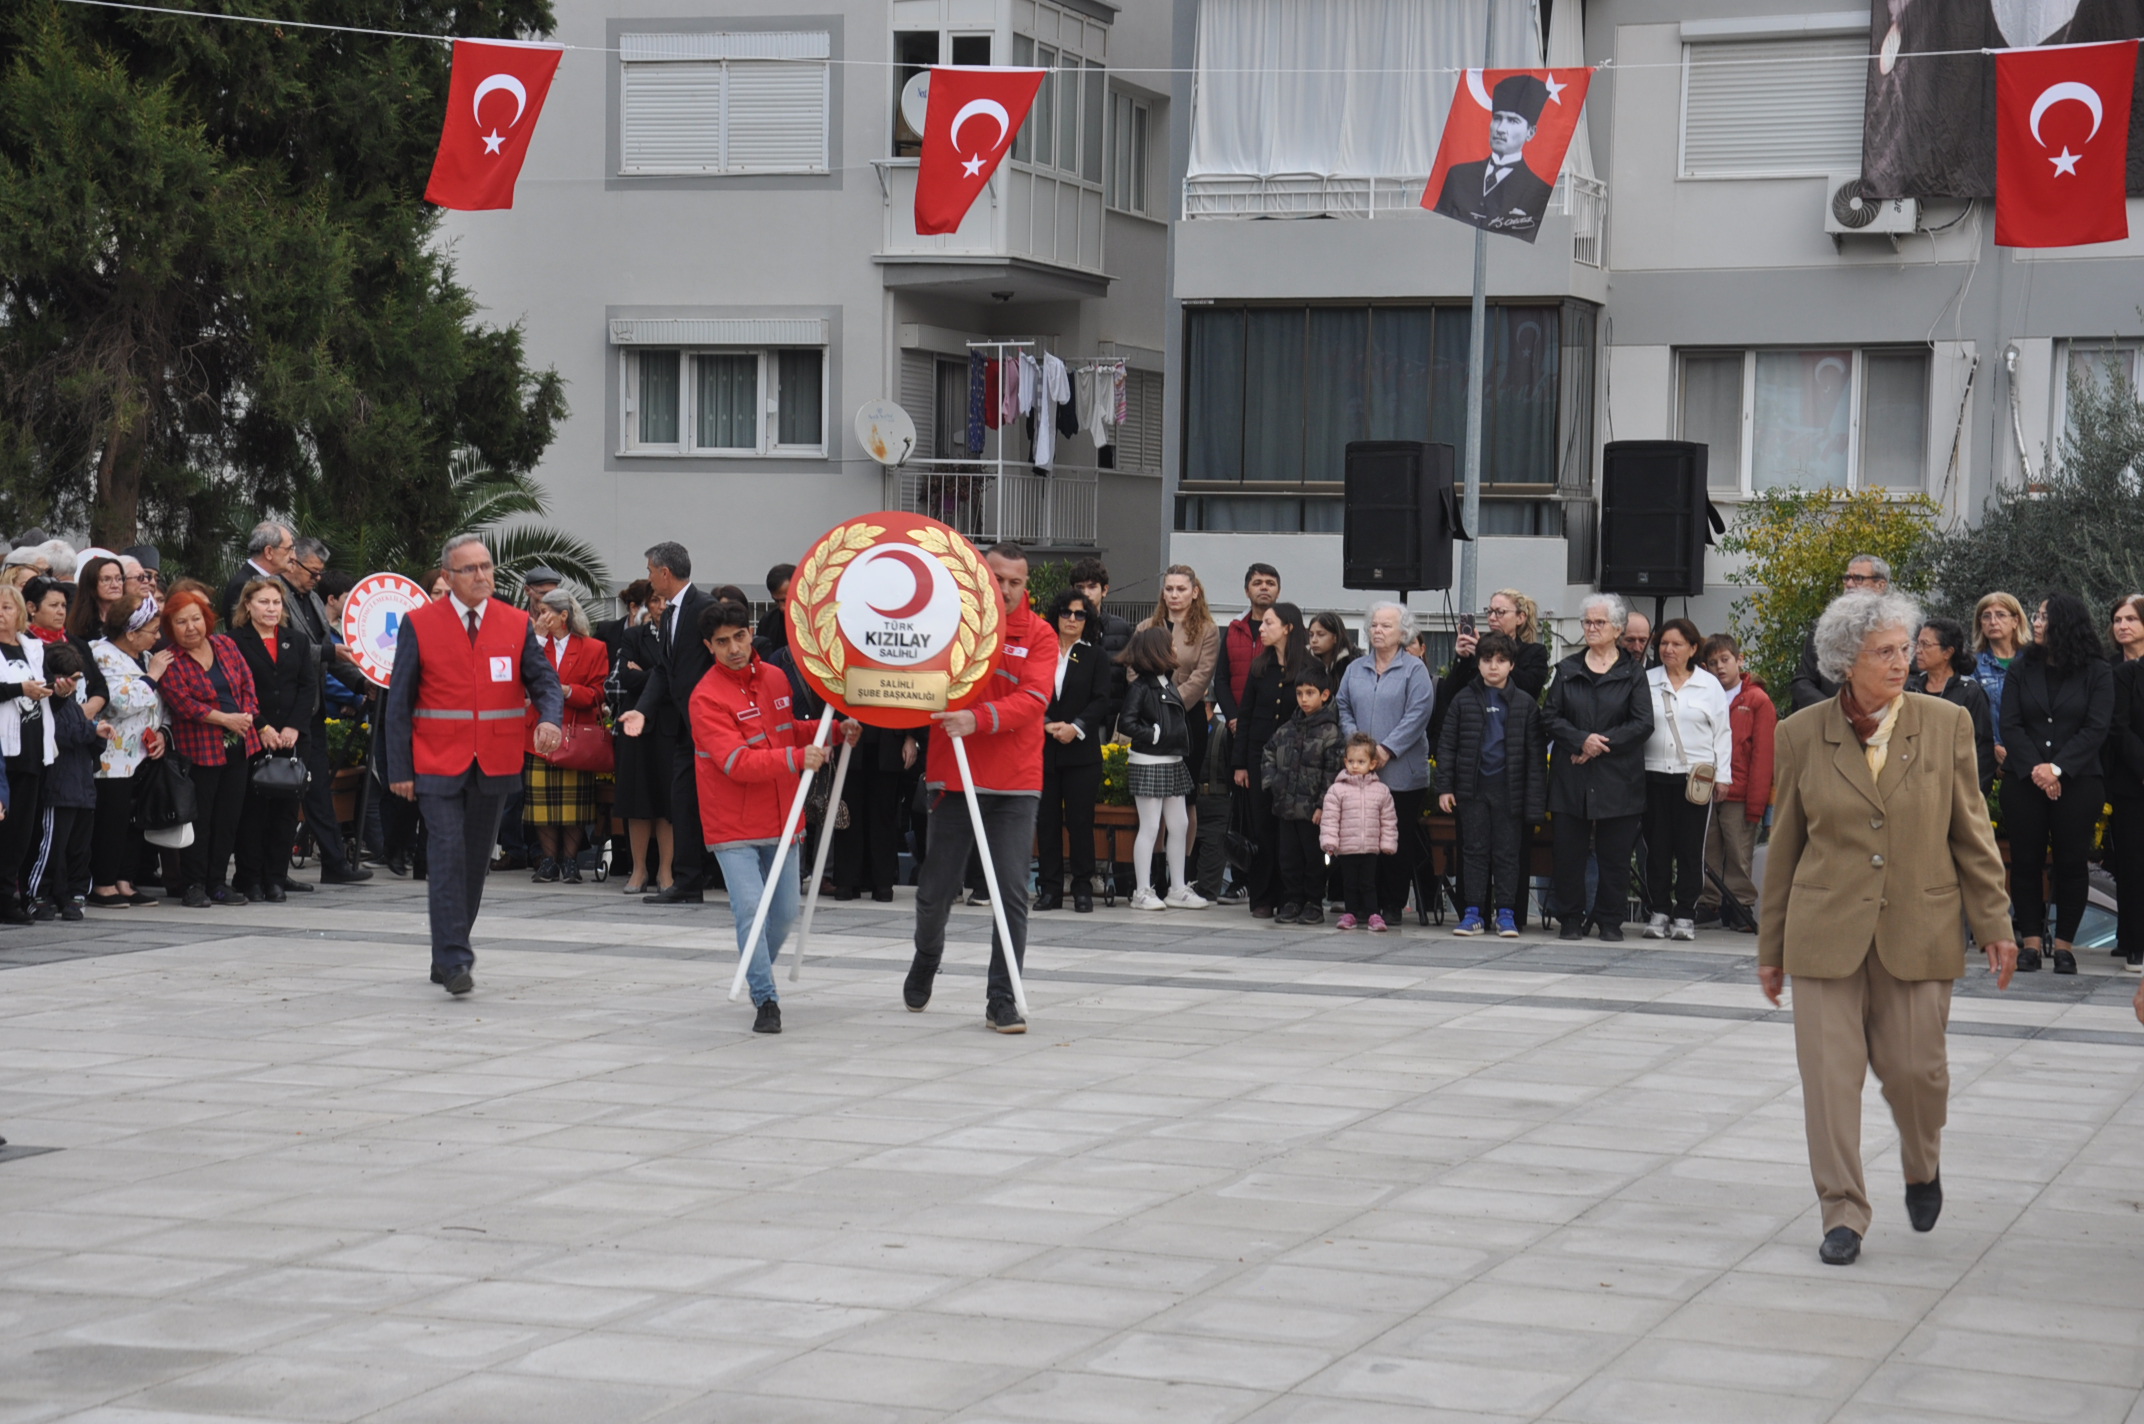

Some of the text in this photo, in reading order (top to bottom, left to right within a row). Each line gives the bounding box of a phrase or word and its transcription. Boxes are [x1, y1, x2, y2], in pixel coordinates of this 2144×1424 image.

[884, 620, 914, 631] TÜRK
[865, 631, 931, 648] KIZILAY
[879, 648, 917, 659] SALİHLİ
[880, 678, 914, 689] SALİHLİ
[858, 688, 935, 701] ŞUBE BAŞKANLIĞI
